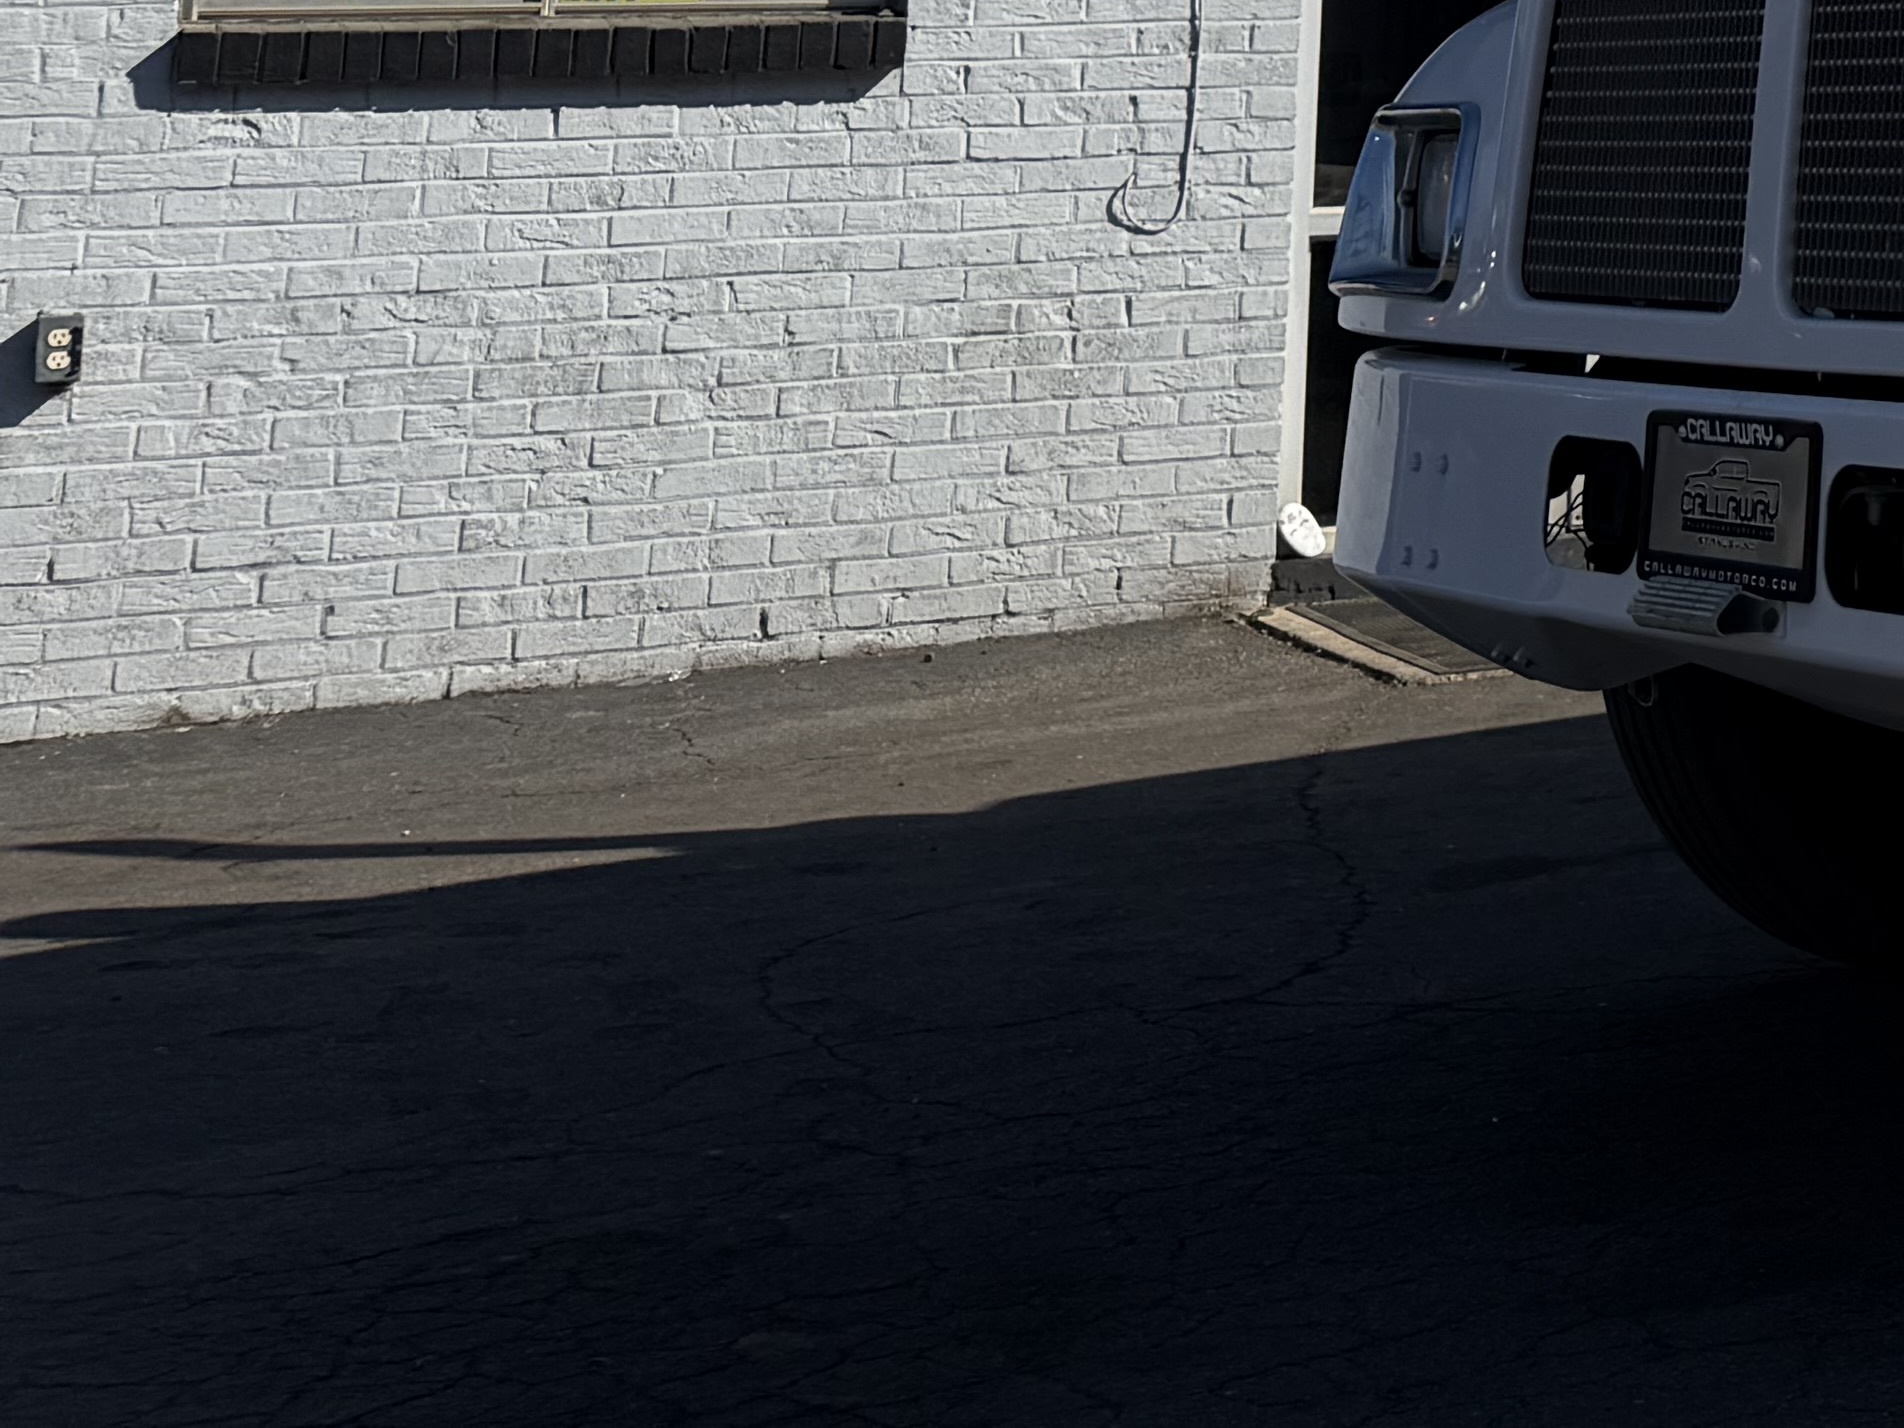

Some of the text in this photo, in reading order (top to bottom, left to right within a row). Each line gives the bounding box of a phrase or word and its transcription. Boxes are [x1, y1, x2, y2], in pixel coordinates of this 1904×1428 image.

[1686, 417, 1774, 447] CALLAWAY
[1681, 490, 1778, 525] CALLAWAY
[1643, 560, 1798, 592] CALLAWAYMOTORCO.COM
